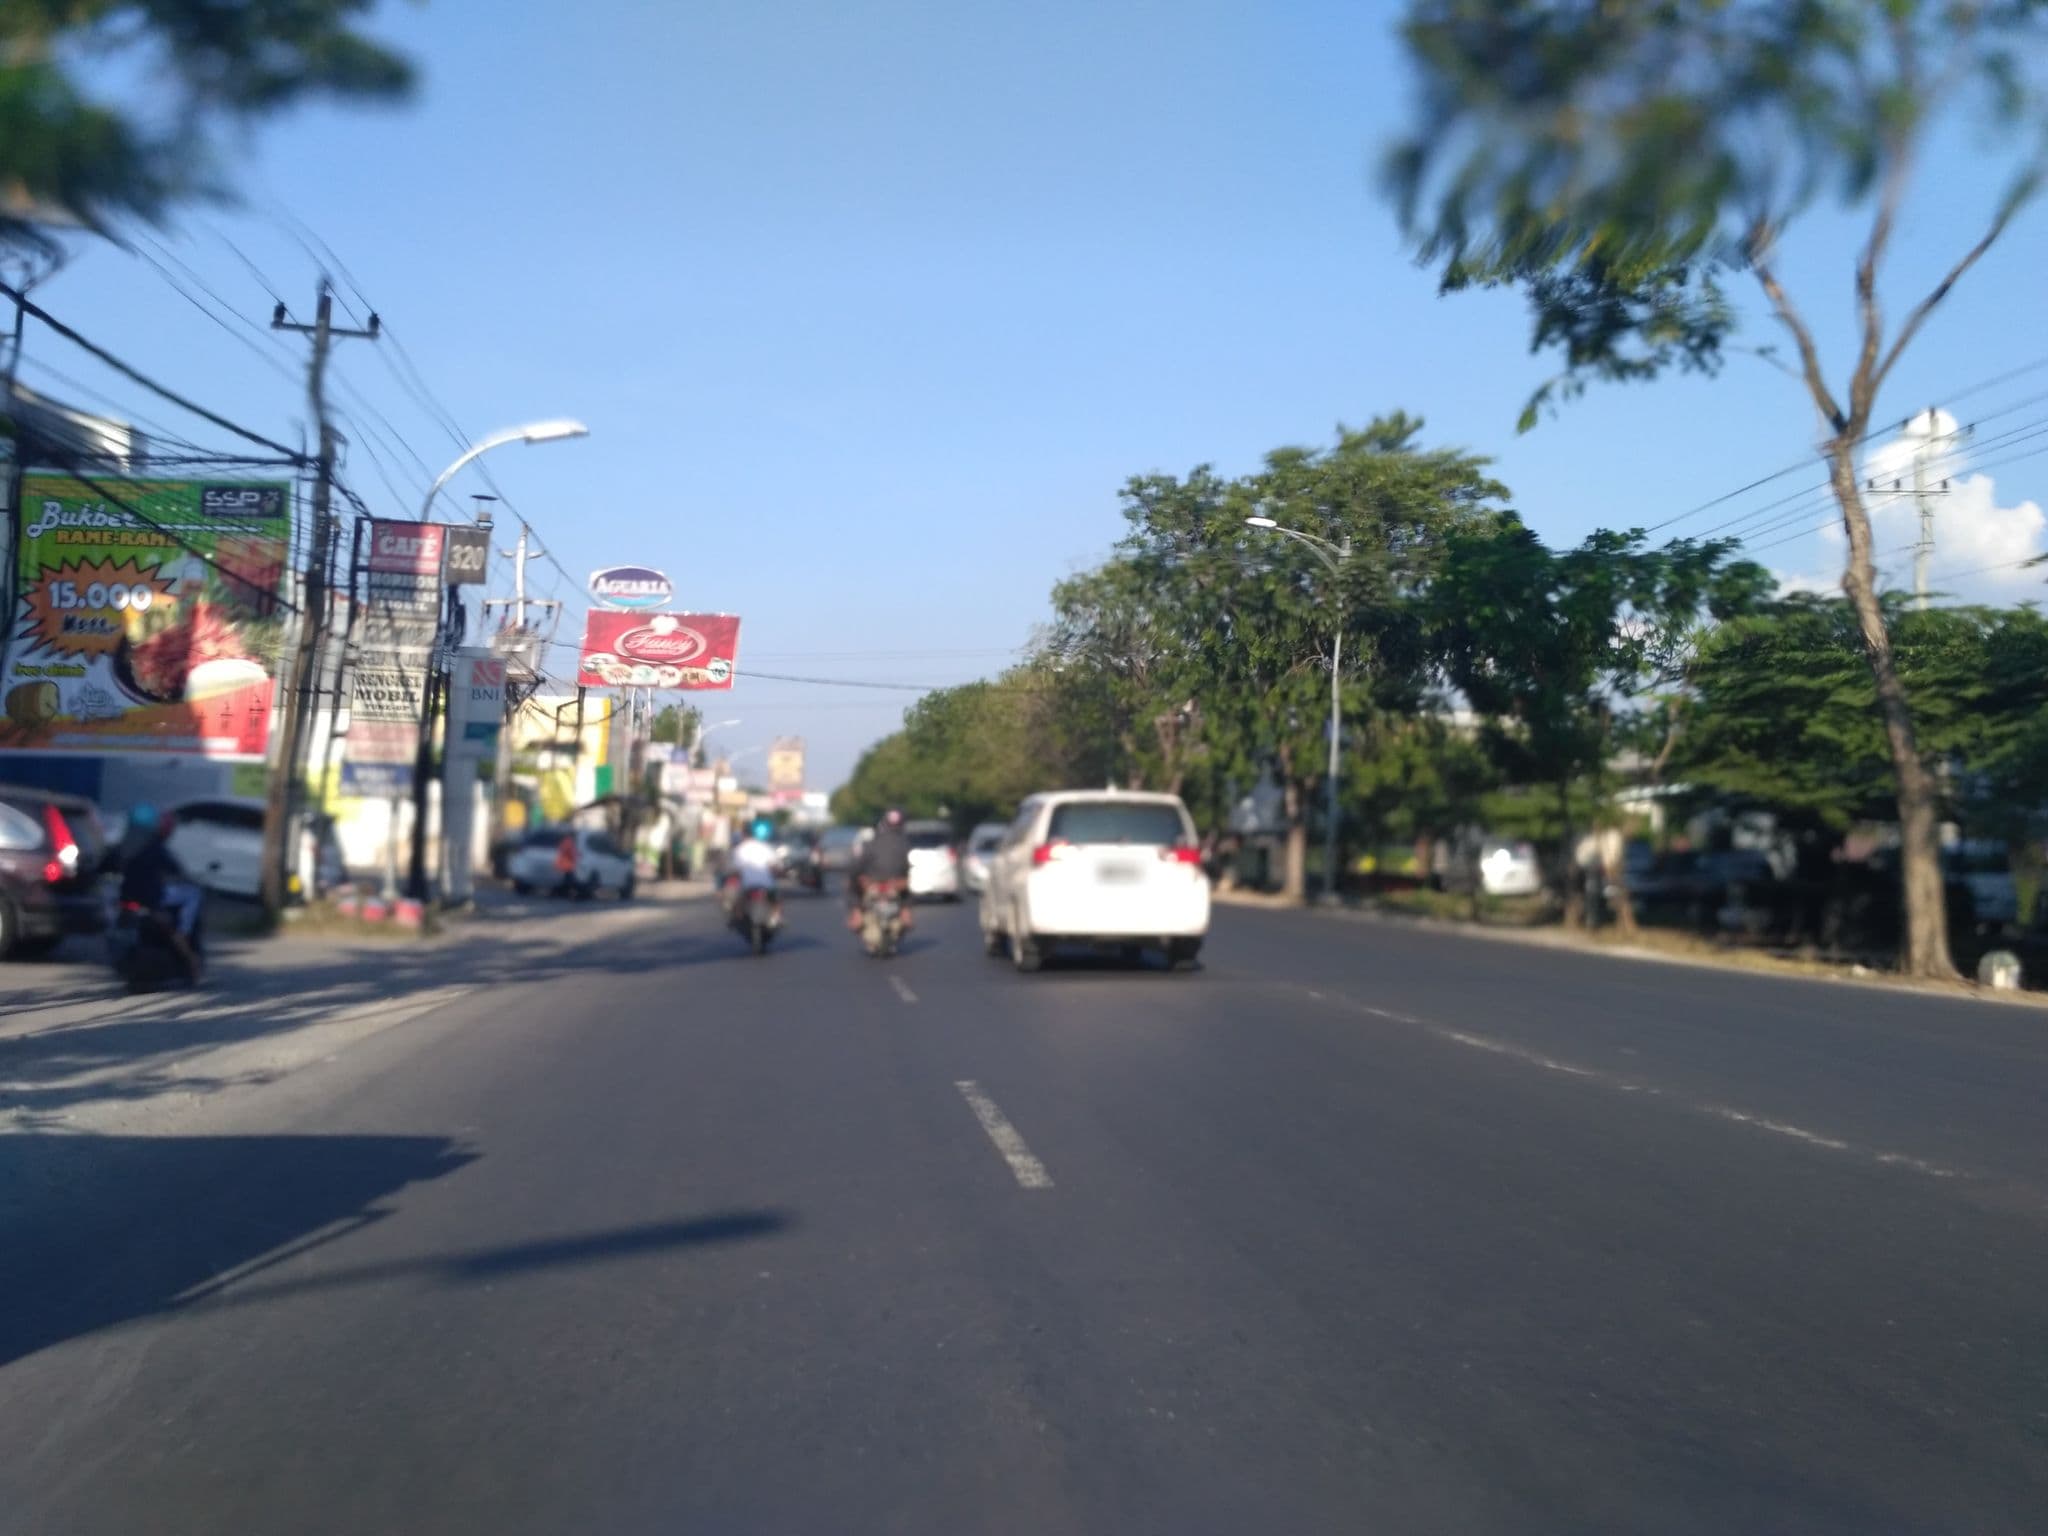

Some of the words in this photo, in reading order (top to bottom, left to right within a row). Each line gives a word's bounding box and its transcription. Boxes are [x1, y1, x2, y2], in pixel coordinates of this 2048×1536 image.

[205, 490, 261, 507] SSP
[379, 533, 439, 558] CAFÉ
[449, 544, 485, 571] 320
[49, 581, 152, 612] 15.000
[355, 689, 420, 703] MOBIL
[472, 687, 500, 700] BNI
